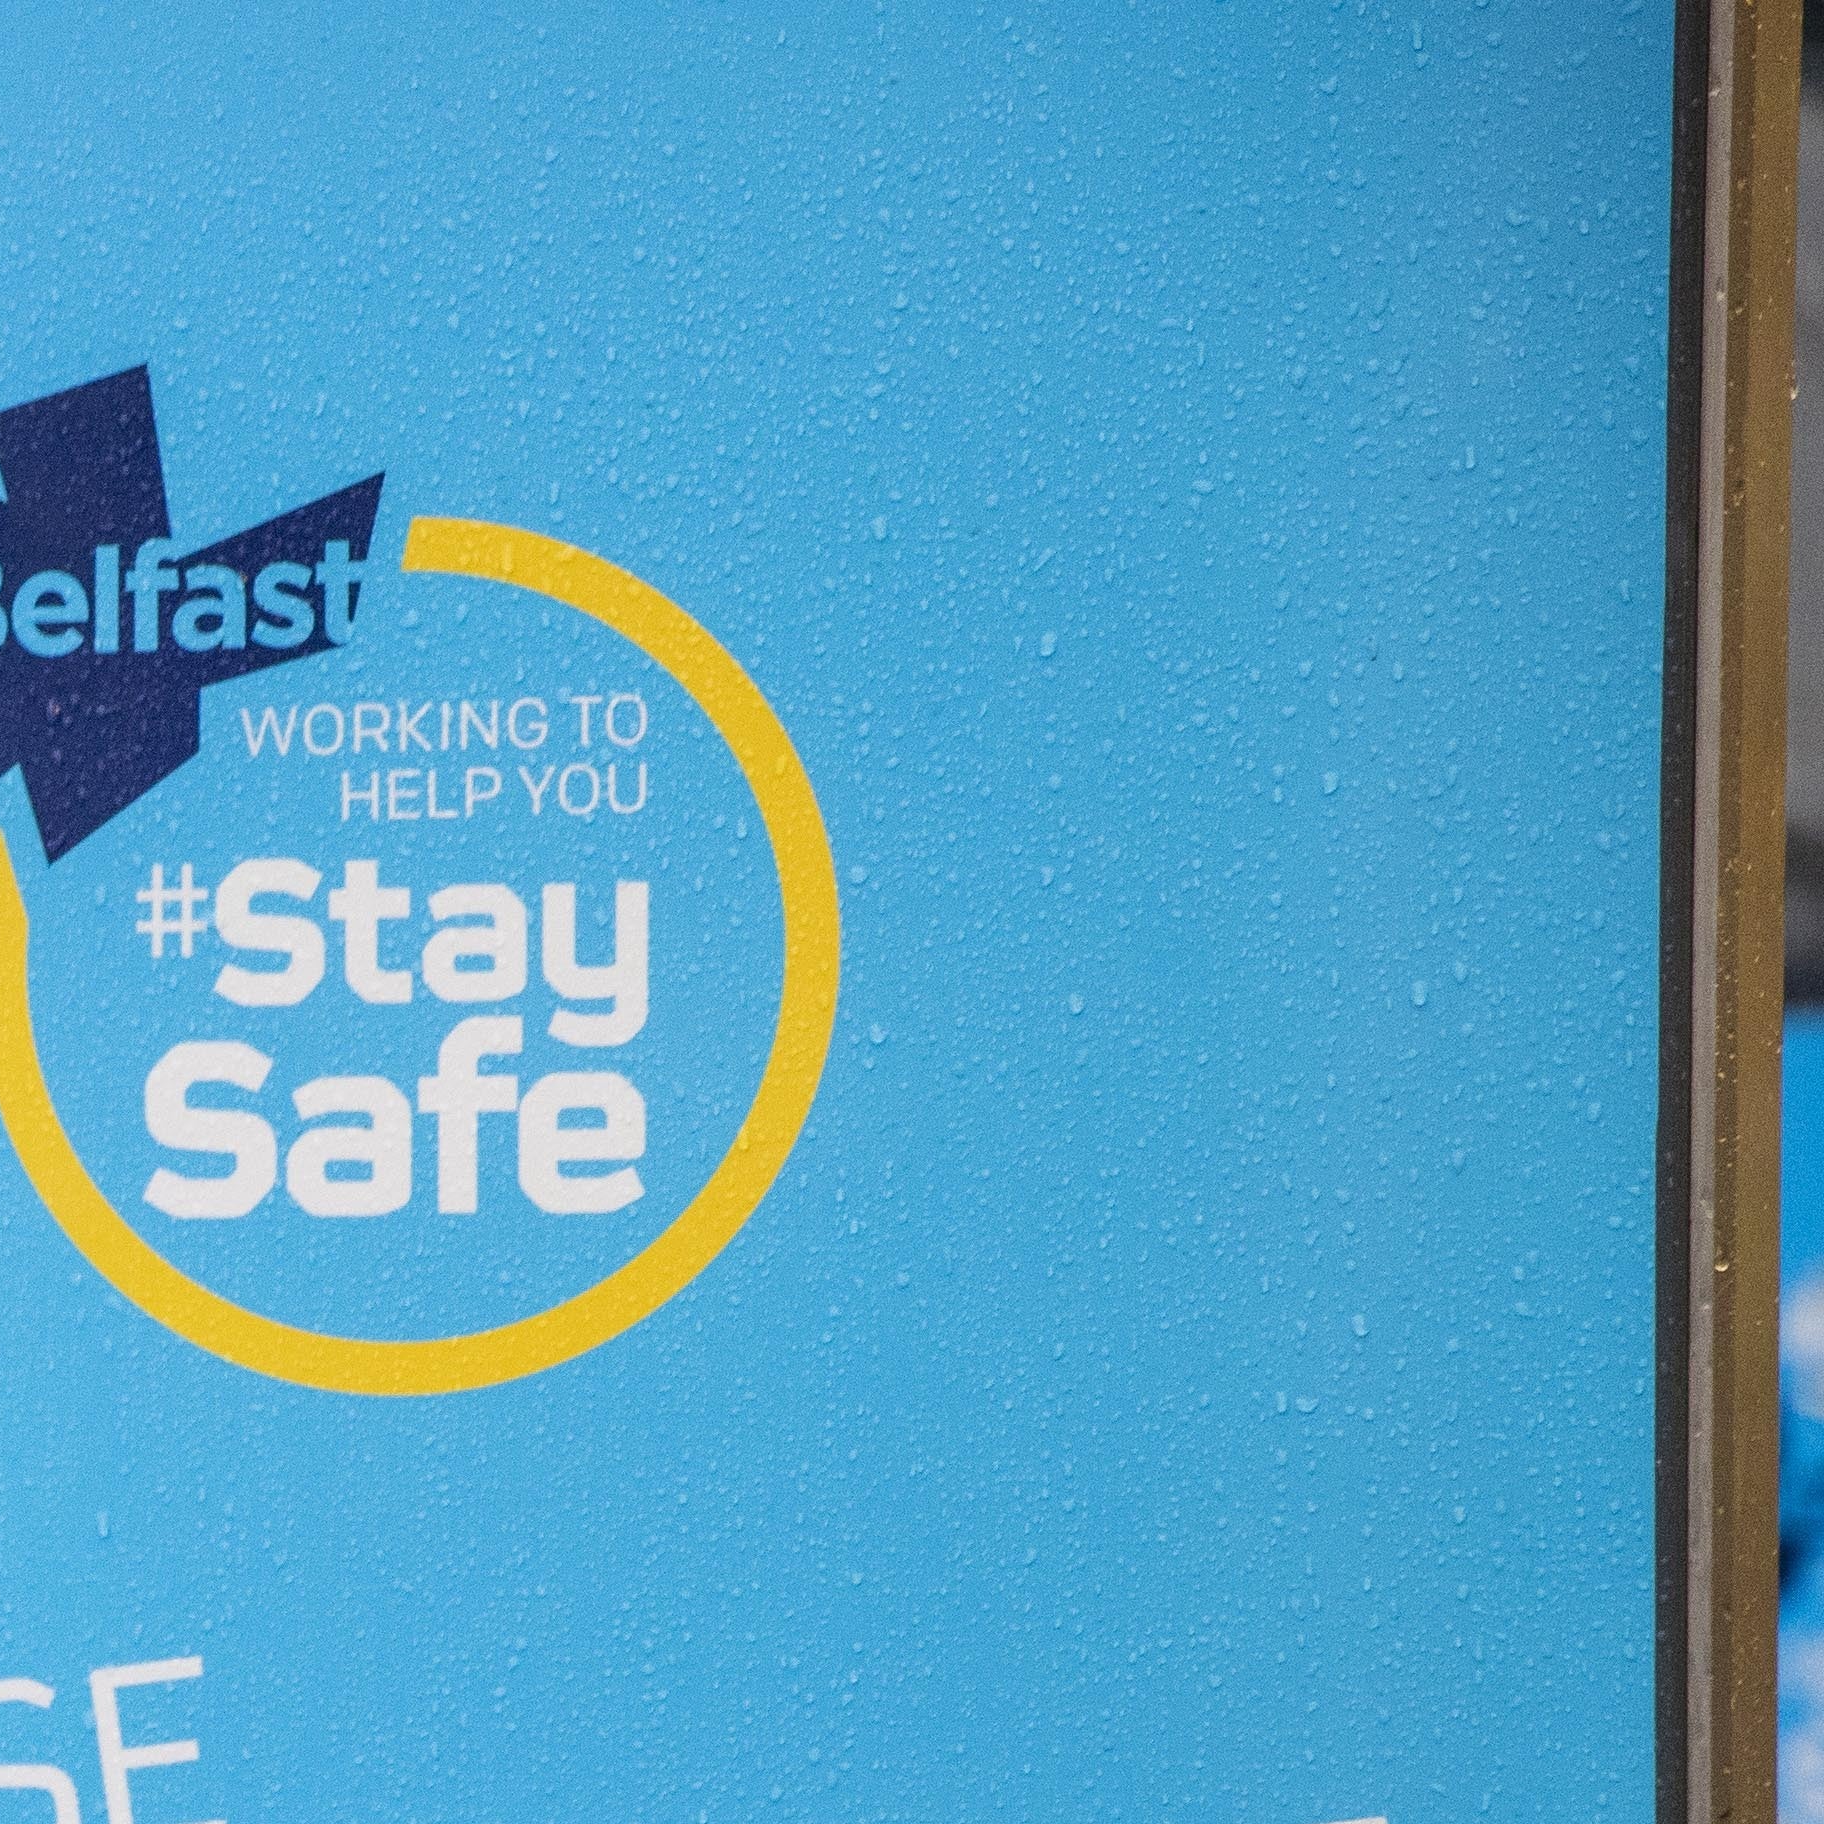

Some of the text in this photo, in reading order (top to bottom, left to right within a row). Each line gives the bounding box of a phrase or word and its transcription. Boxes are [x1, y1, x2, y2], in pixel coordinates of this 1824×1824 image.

[240, 693, 650, 759] WORKING TO
[340, 764, 650, 823] HELP YOU
[136, 857, 650, 1047] #Stay
[142, 1015, 646, 1220] Safe
